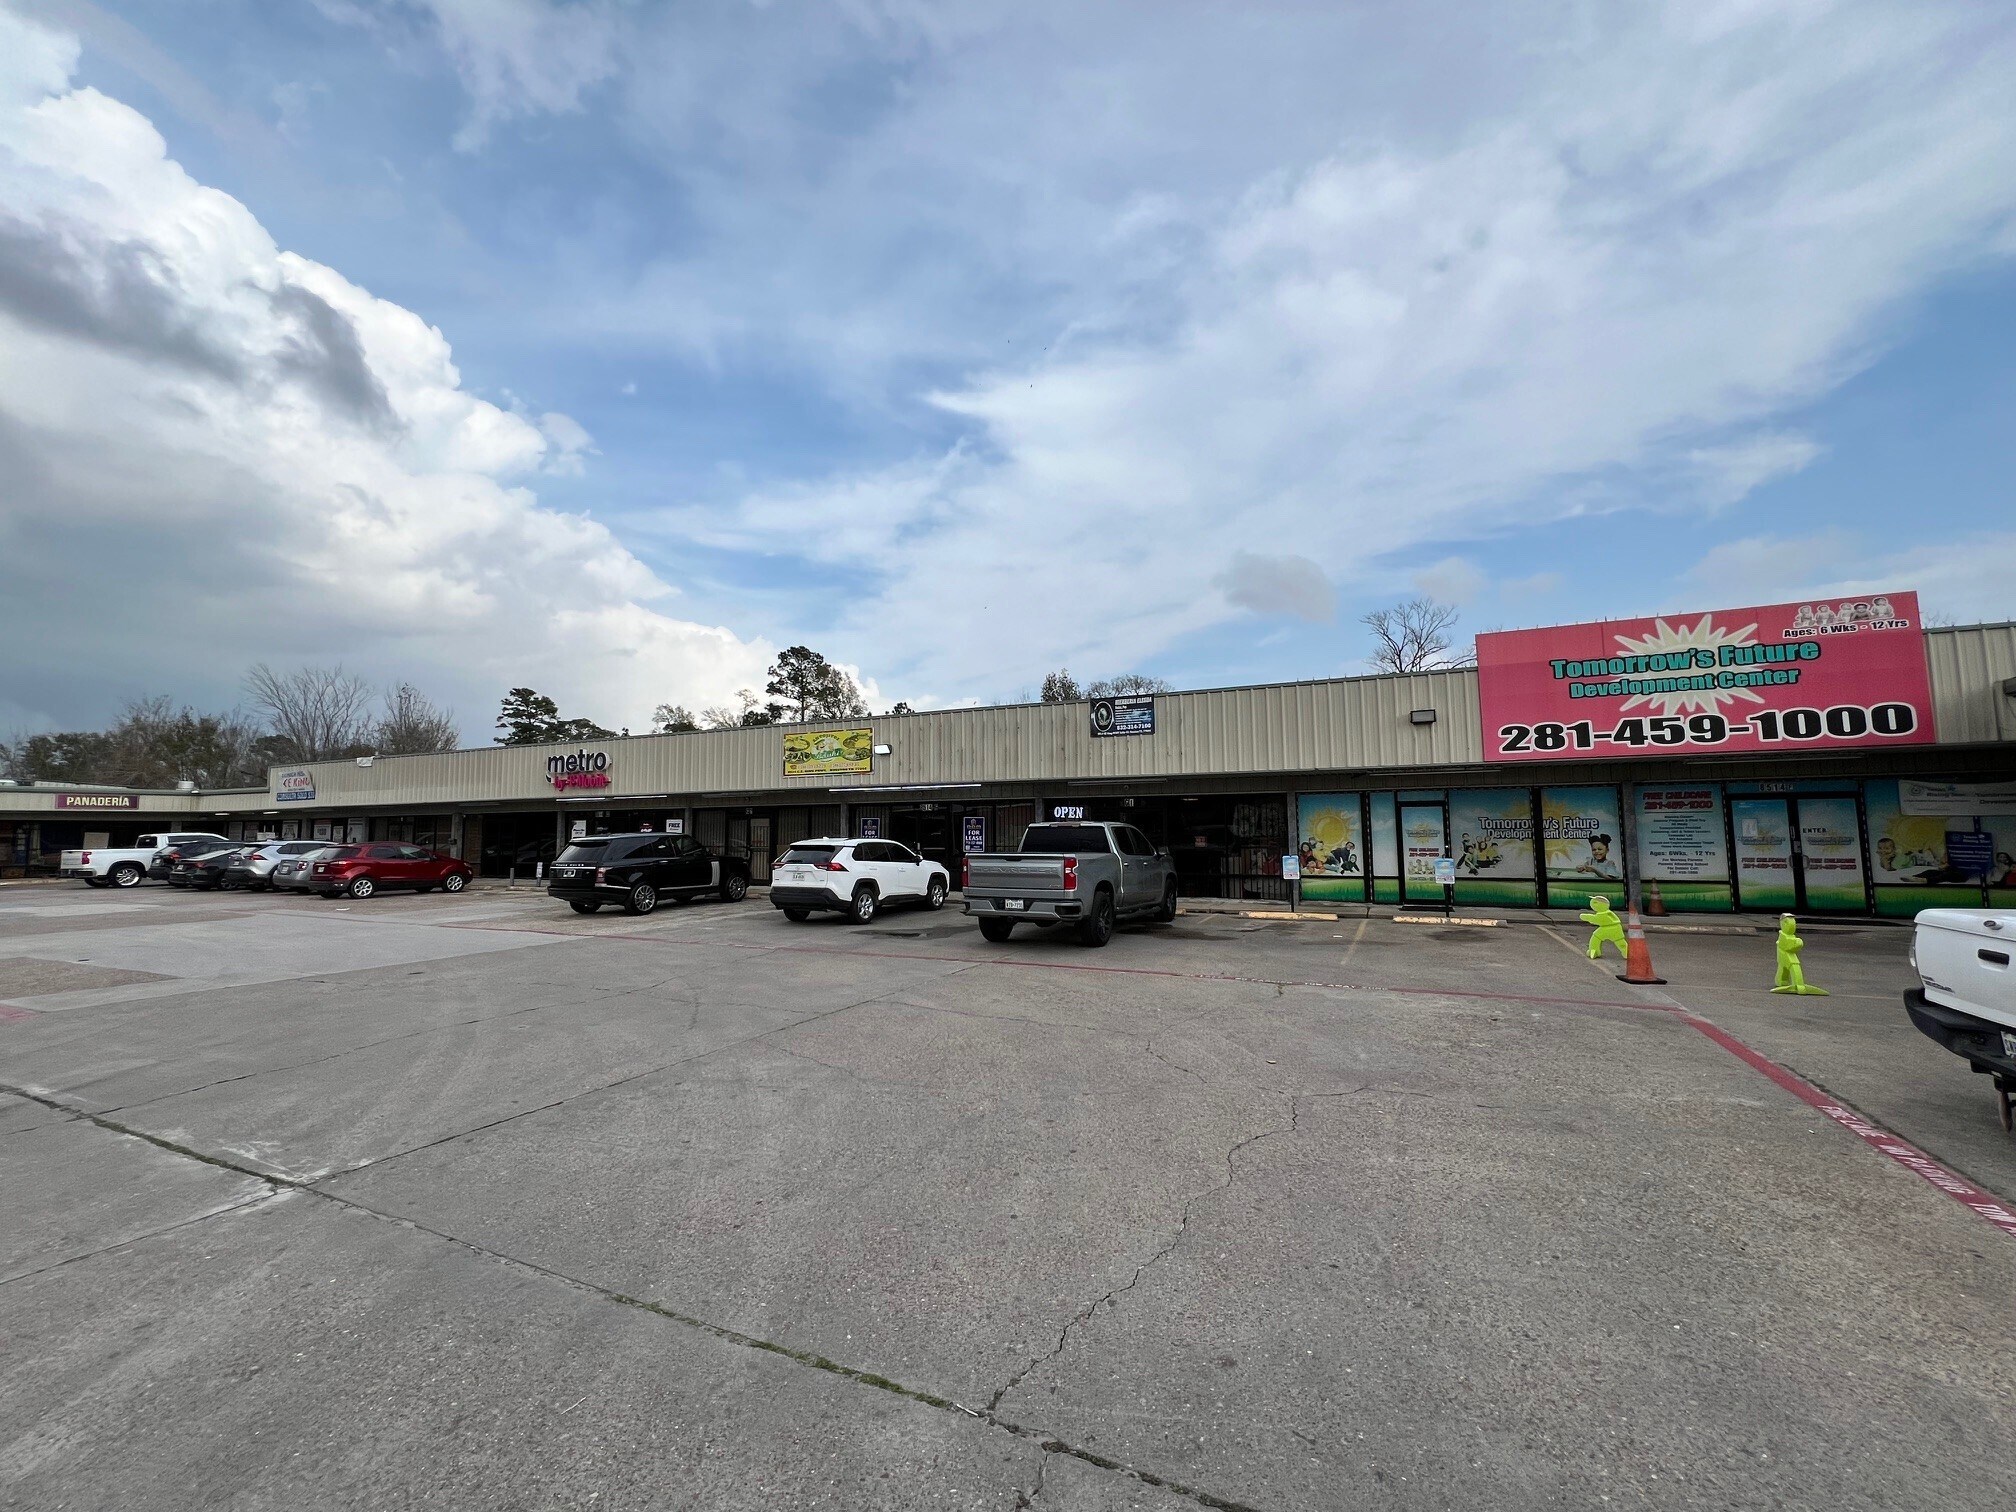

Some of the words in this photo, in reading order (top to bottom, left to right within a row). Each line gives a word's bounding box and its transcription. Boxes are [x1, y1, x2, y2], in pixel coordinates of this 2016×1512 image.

[1783, 627, 1817, 640] Ages:
[1820, 625, 1829, 635] 6
[1830, 622, 1858, 634] Wks
[1871, 620, 1885, 632] 12
[1886, 618, 1909, 631] Yrs
[1551, 647, 1714, 679] Tomorrow's
[1720, 641, 1819, 665] Future
[1570, 674, 1716, 698] Development
[1718, 669, 1800, 689] Center
[1499, 703, 1917, 752] 281-459-1000
[547, 748, 609, 773] metro
[66, 796, 130, 806] PANADERÍA
[1054, 806, 1084, 819] OPEN
[1562, 816, 1600, 829] Future
[1561, 828, 1593, 839] Center
